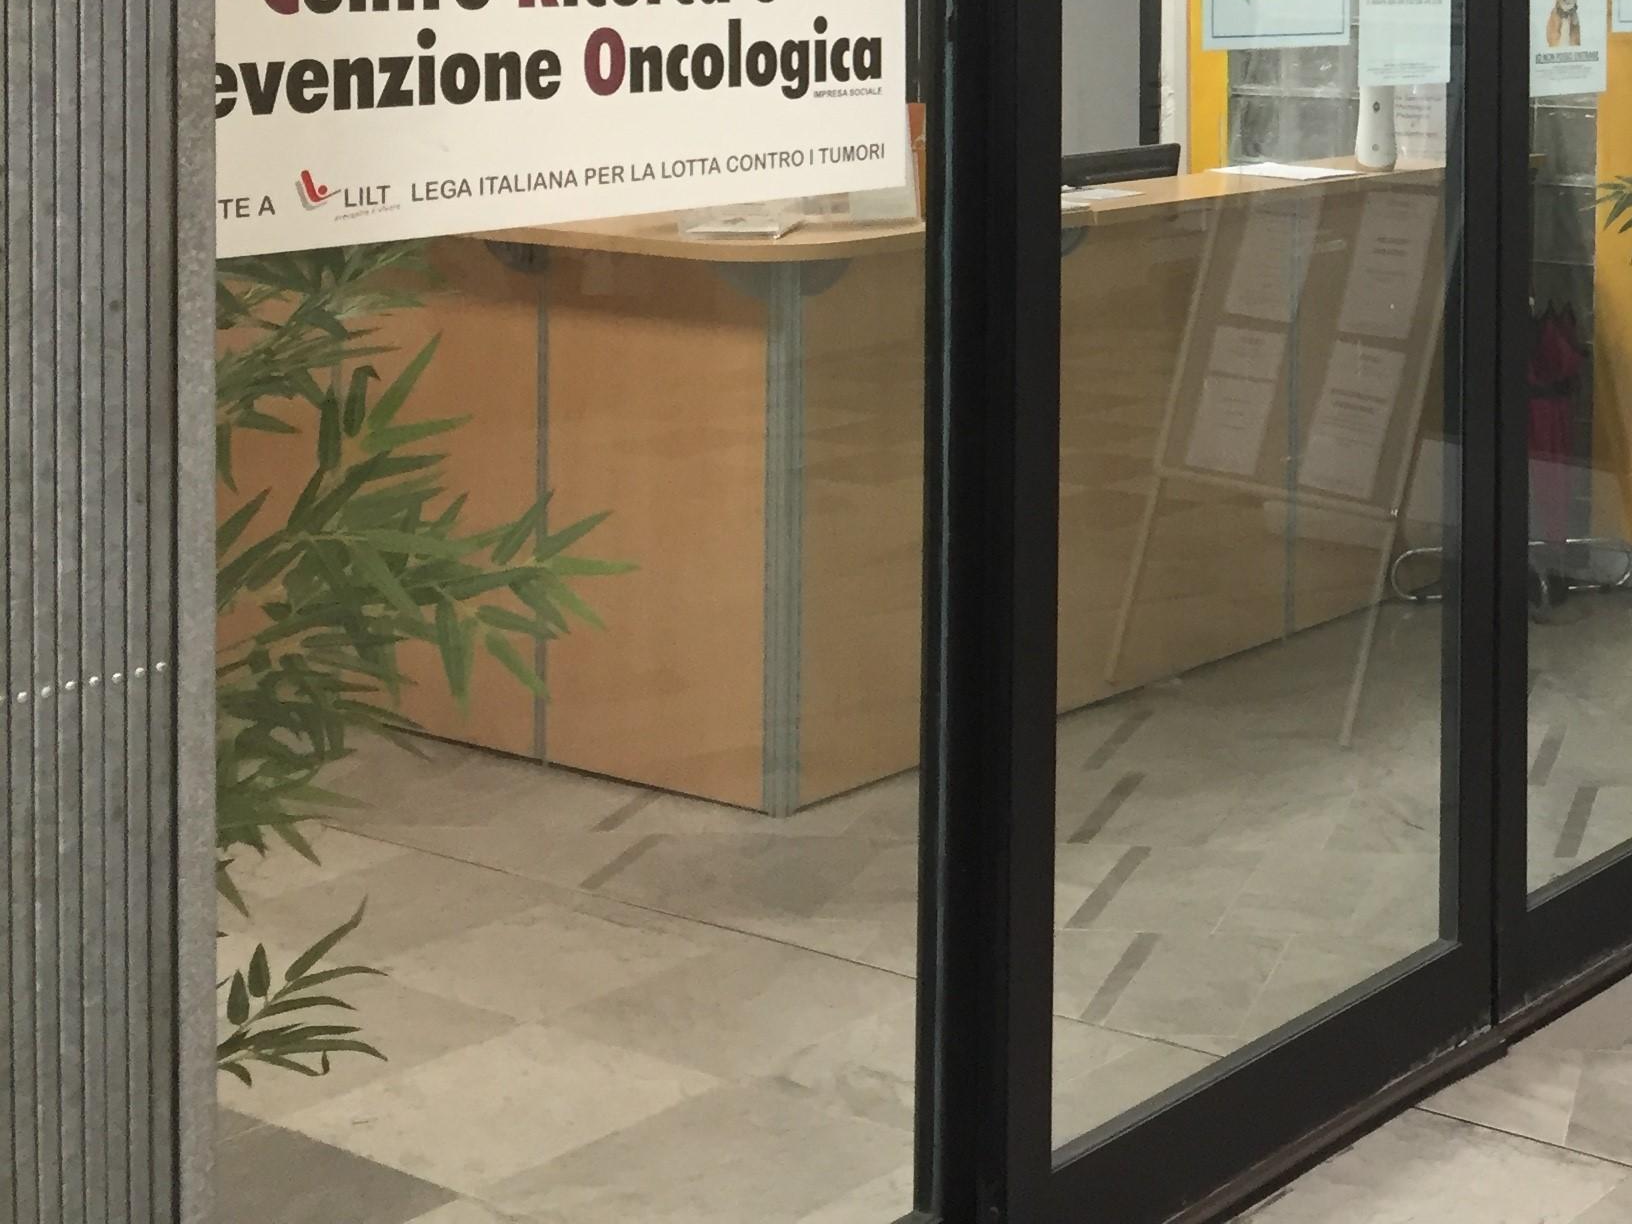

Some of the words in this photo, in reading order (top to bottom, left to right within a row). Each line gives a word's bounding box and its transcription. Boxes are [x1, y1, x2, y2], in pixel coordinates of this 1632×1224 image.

[584, 16, 882, 100] Oncologica
[814, 89, 847, 98] IMPRESA
[850, 87, 882, 96] SOCIALE
[258, 195, 275, 216] A
[345, 185, 390, 208] LILT
[412, 178, 472, 201] LEGA
[478, 170, 577, 198] ITALIANA
[585, 164, 625, 185] PER
[631, 161, 655, 182] LA
[661, 155, 720, 179] LOTTA
[726, 150, 803, 174] CONTRO
[810, 149, 814, 166] I
[819, 142, 885, 165] TUMORI
